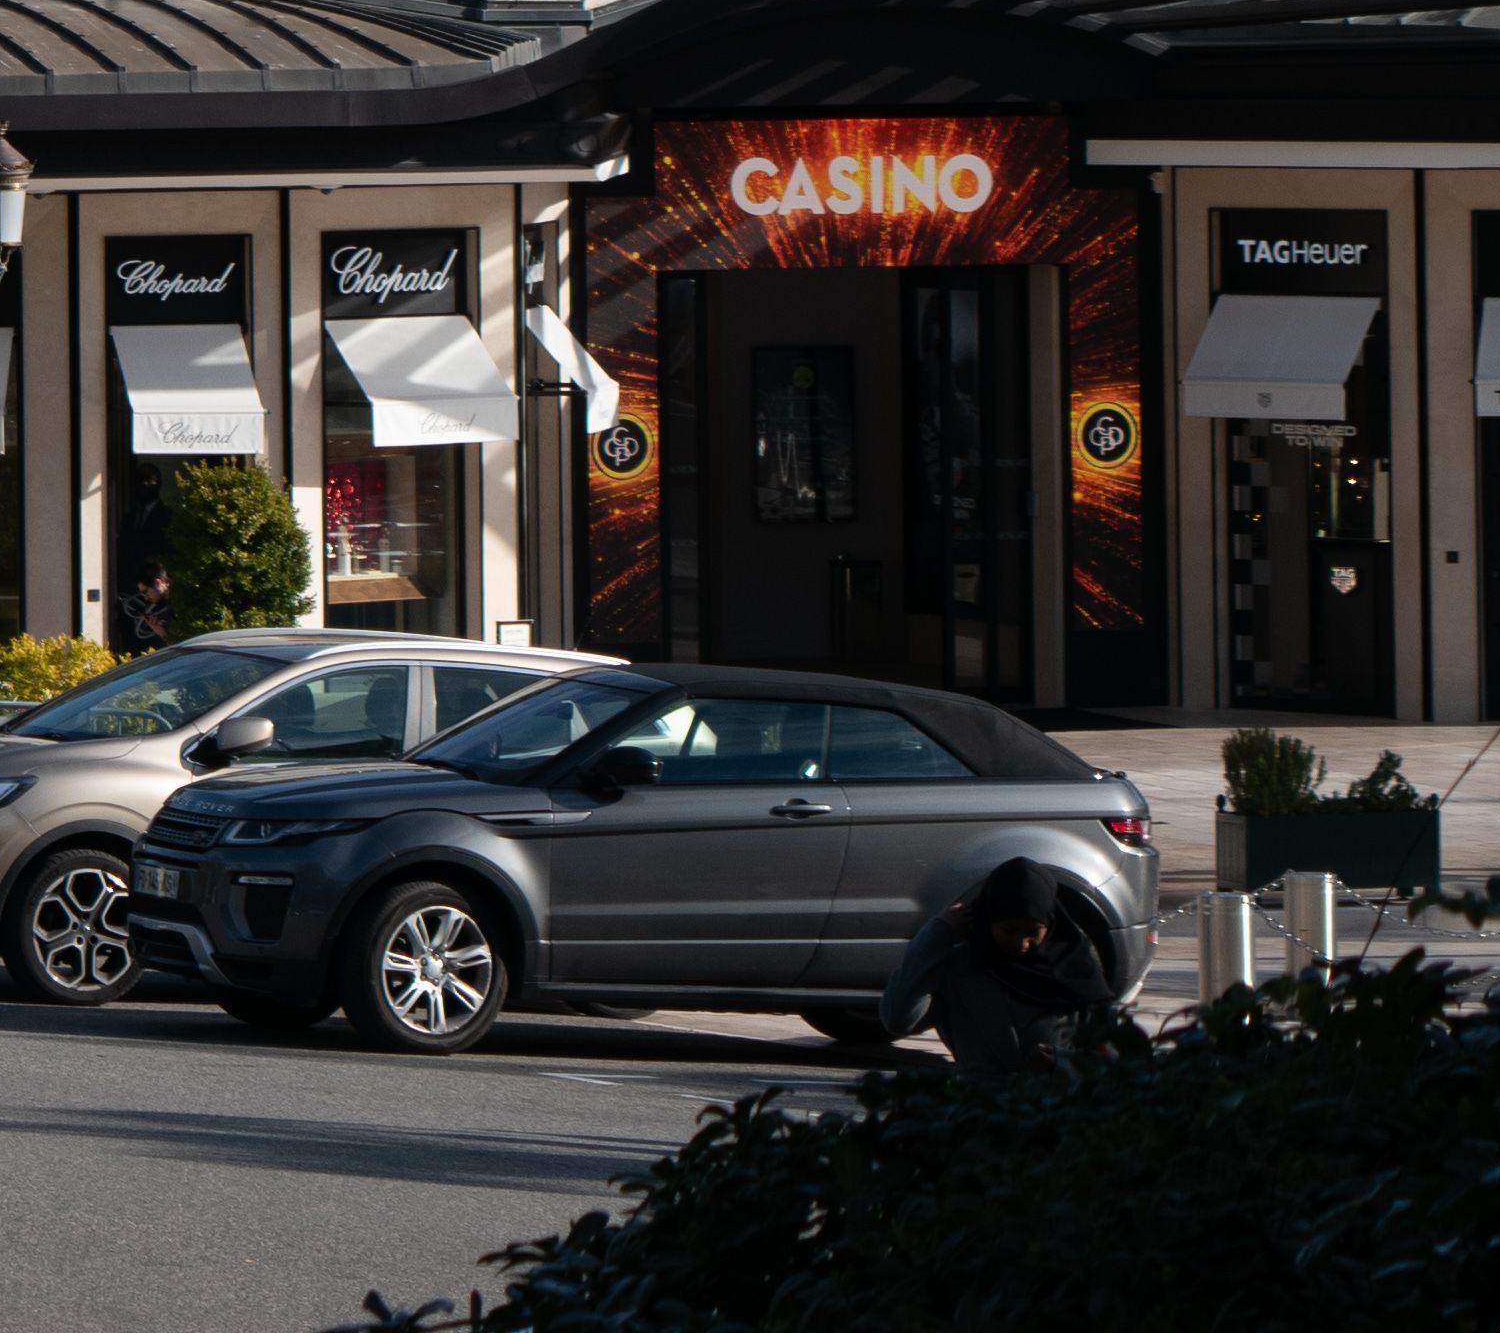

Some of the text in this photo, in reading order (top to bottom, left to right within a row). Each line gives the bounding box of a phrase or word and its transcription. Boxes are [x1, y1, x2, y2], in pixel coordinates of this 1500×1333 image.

[730, 153, 993, 216] CASINO
[117, 259, 236, 302] Chopard
[330, 245, 459, 304] Chopard
[160, 421, 239, 449] Chopard
[1271, 422, 1358, 437] DESIGNED
[1284, 435, 1345, 448] TO WIN
